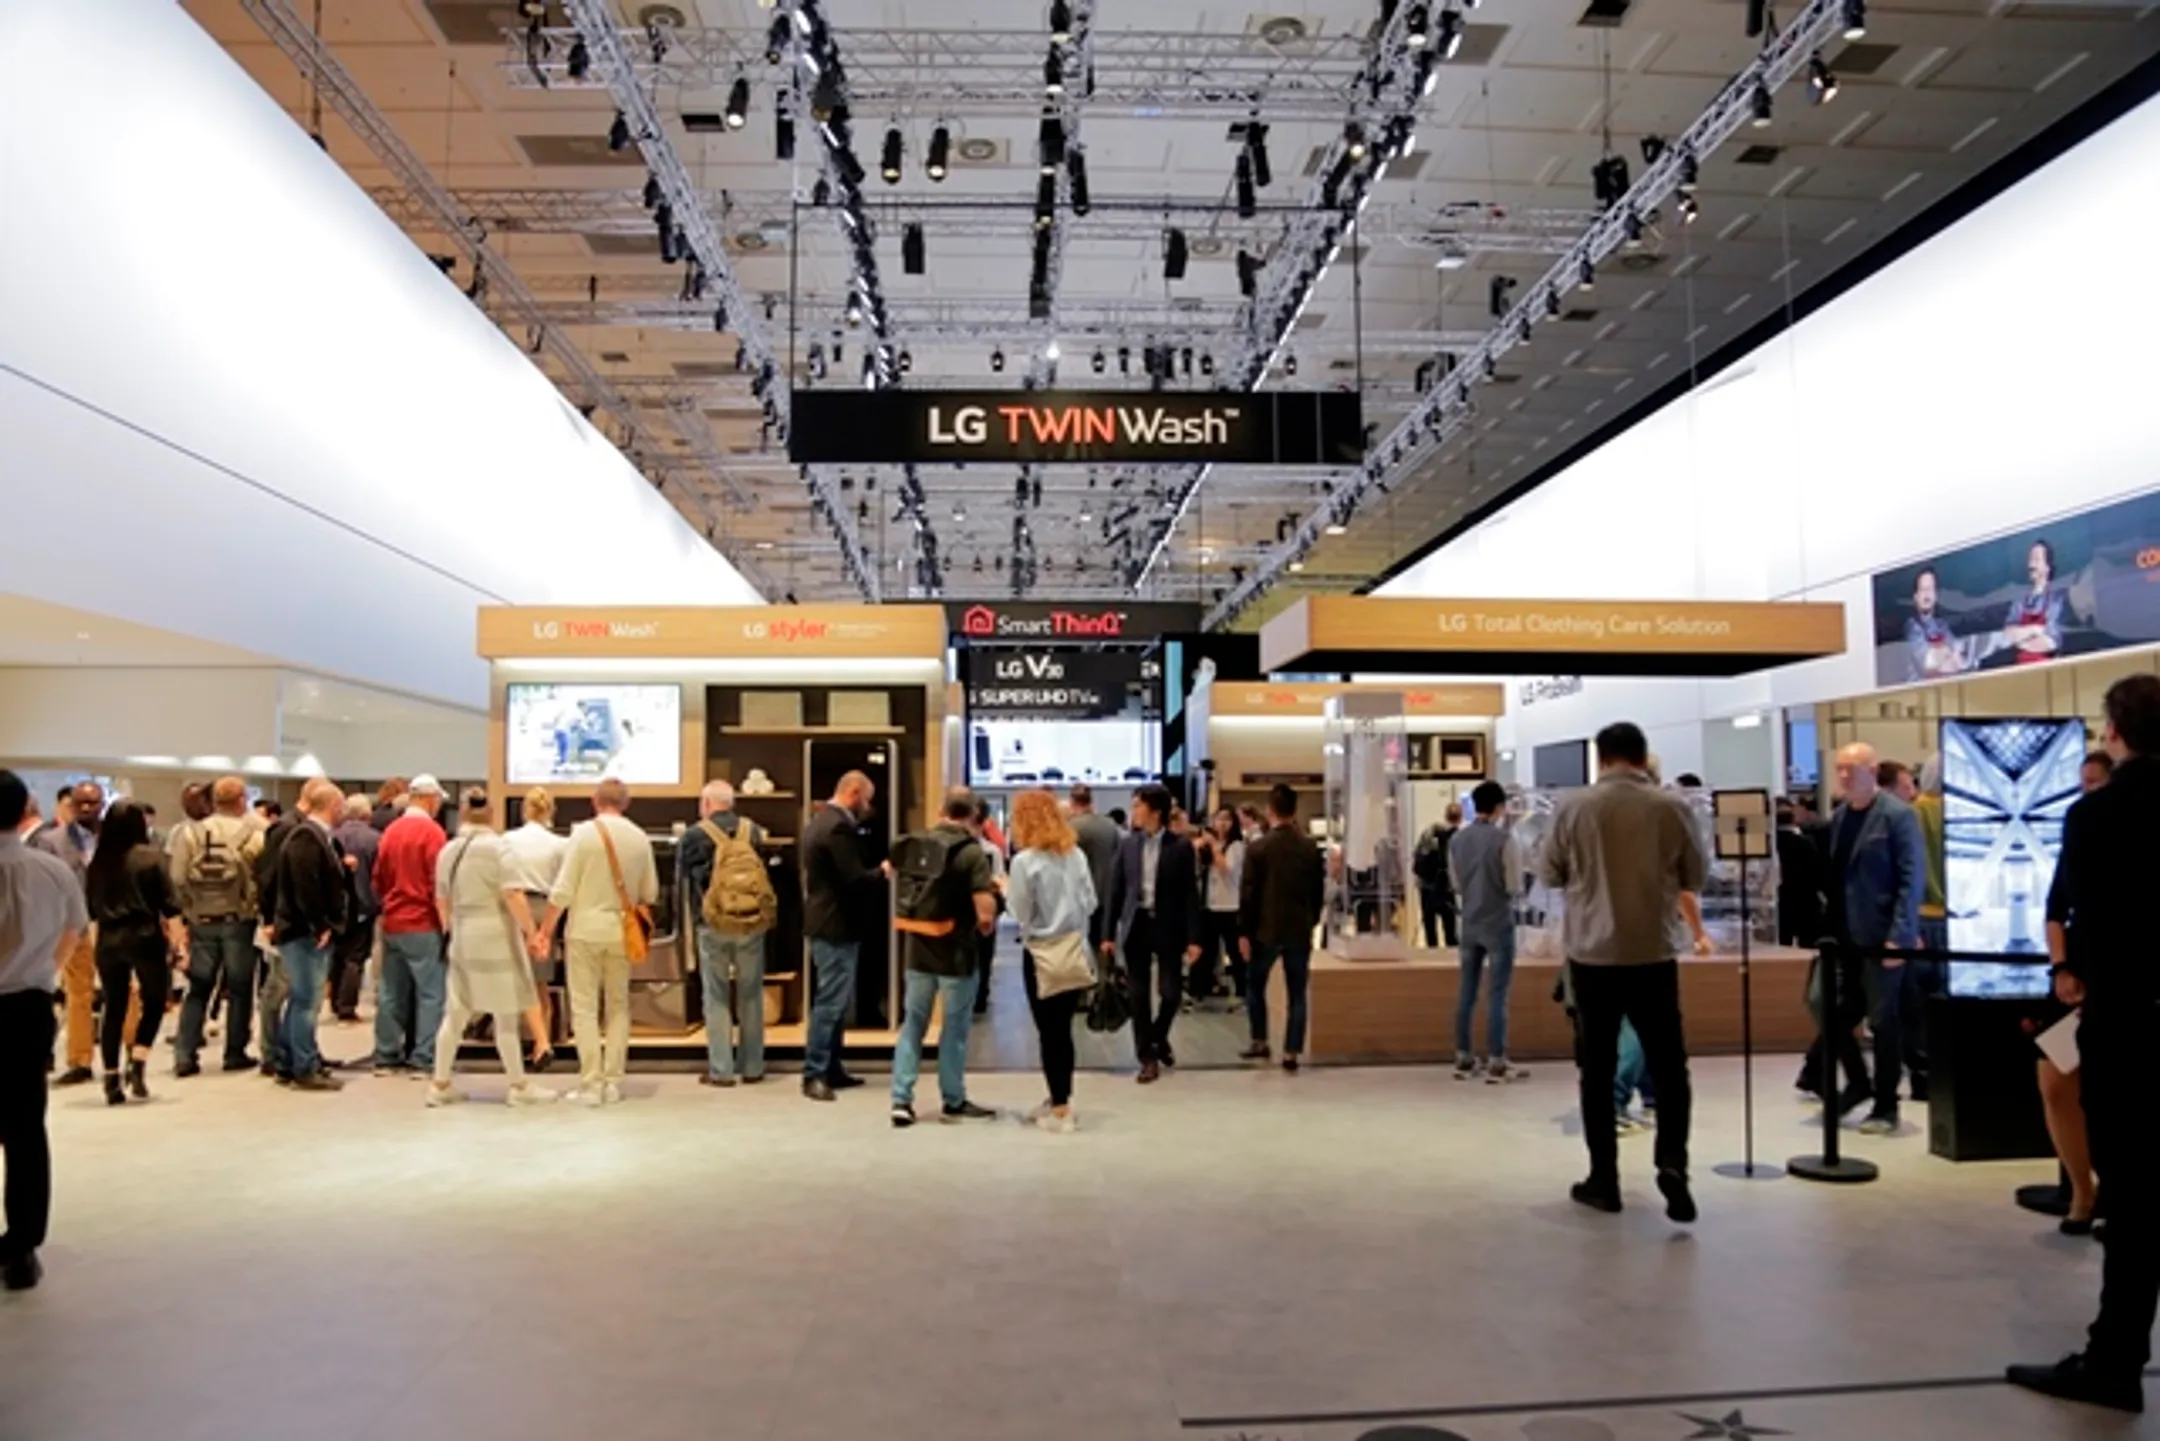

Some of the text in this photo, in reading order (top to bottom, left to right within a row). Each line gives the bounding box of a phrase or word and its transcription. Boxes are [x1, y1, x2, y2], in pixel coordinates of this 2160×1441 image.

[928, 406, 987, 444] LG
[533, 621, 559, 639] LG
[1438, 613, 1730, 638] LG Total Clothing Care Solution
[995, 661, 1024, 679] LG
[979, 688, 1034, 704] SUPER
